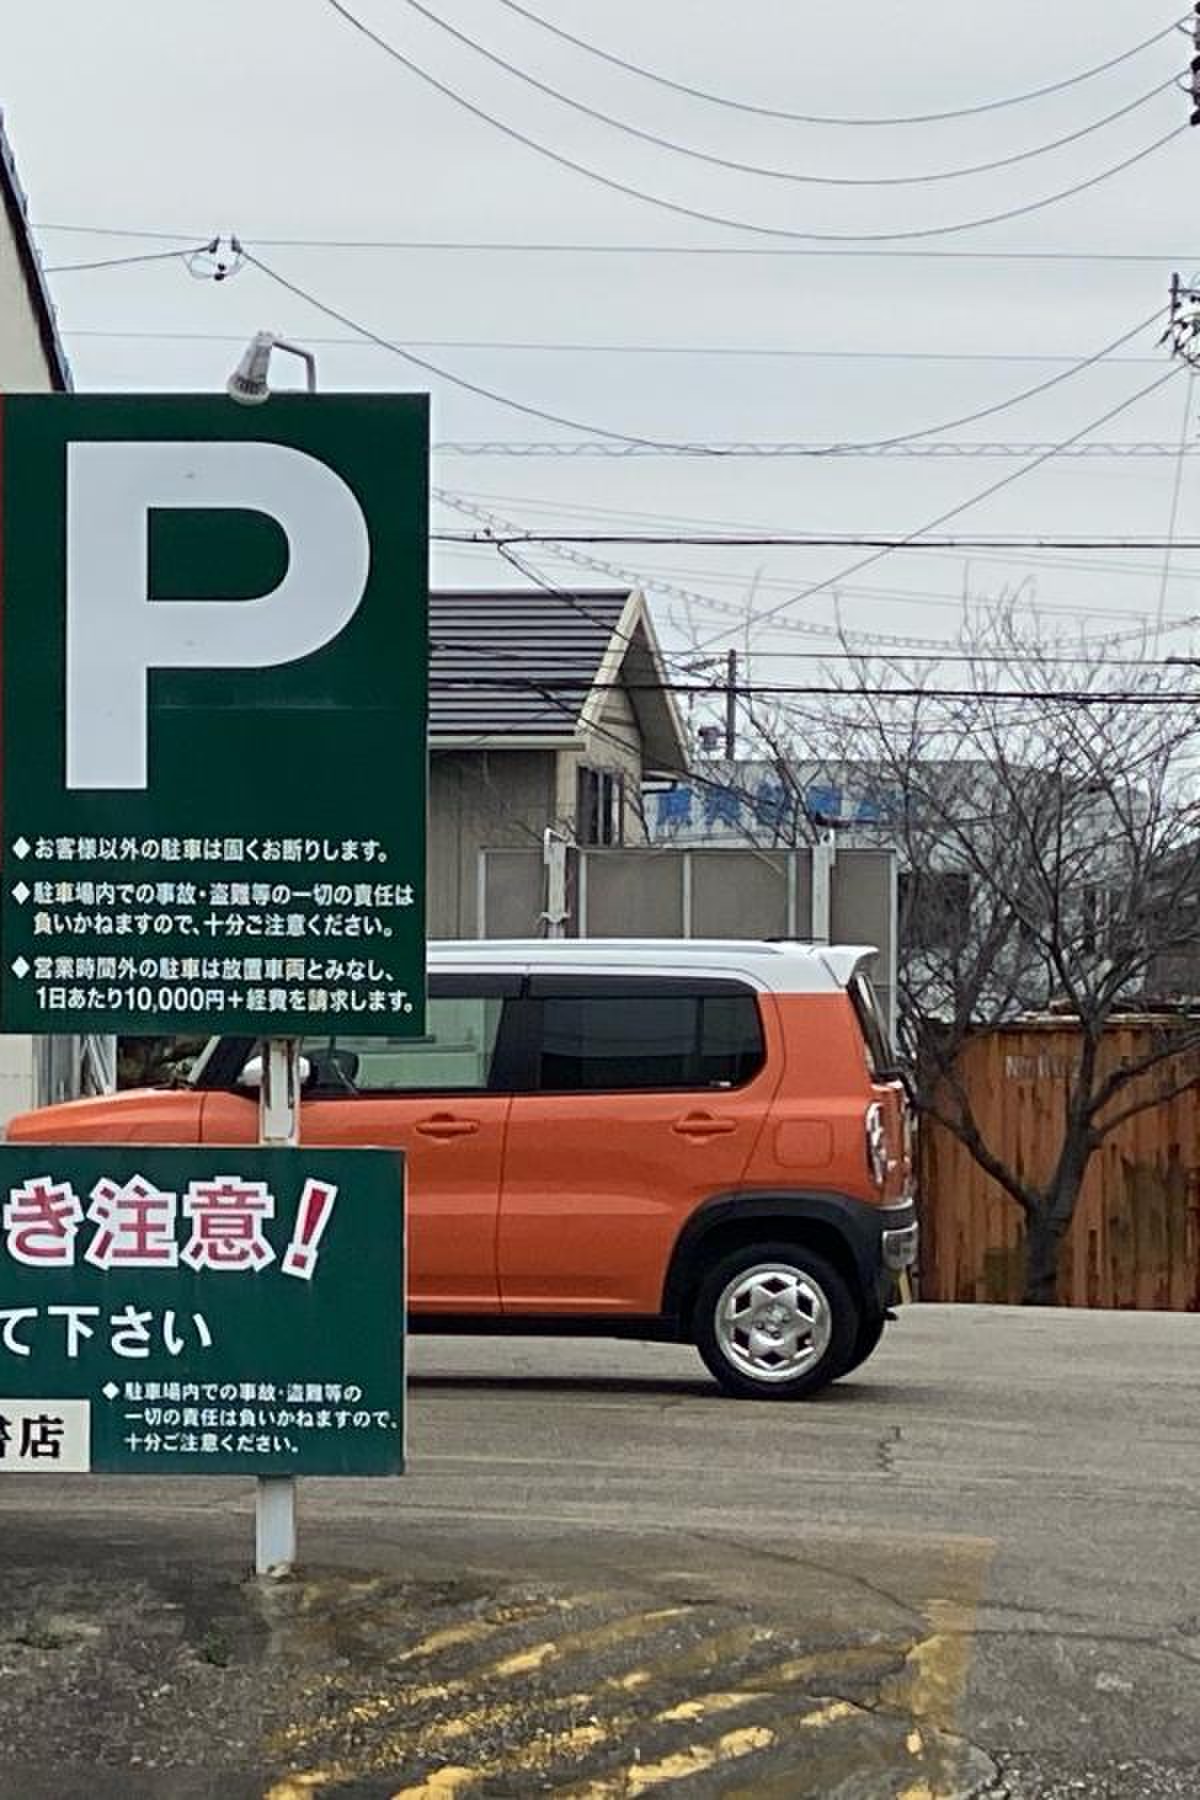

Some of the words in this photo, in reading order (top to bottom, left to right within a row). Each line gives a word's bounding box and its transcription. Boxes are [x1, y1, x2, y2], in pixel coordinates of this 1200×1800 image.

[65, 441, 371, 790] P
[34, 836, 387, 863] お客様以外の駐車は固くお断りします。
